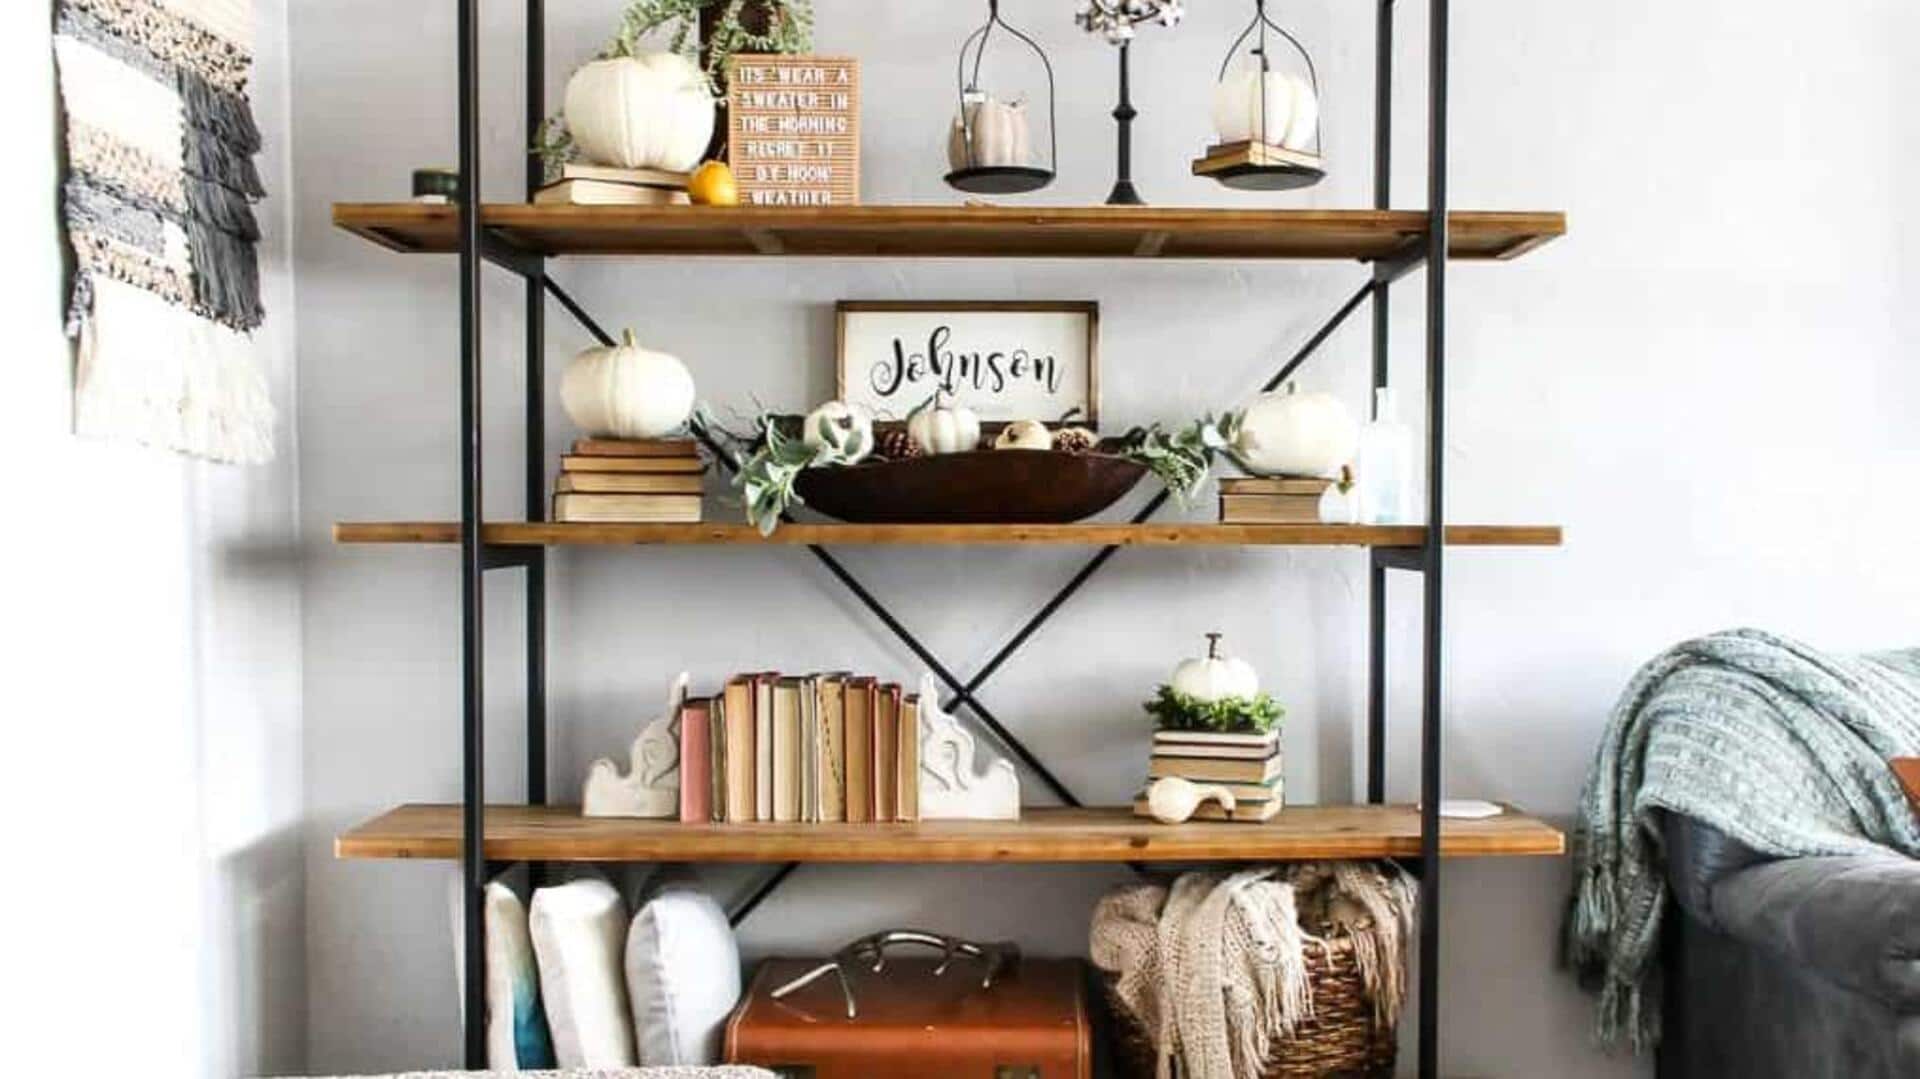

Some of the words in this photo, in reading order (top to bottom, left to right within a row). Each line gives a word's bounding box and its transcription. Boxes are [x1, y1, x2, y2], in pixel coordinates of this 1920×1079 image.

[779, 67, 825, 84] WEAR
[837, 68, 848, 84] A
[742, 91, 818, 109] SWEATER
[832, 92, 848, 109] IN
[741, 116, 768, 133] THE
[779, 117, 847, 134] MORNING
[747, 140, 803, 158] REGRET
[817, 142, 832, 158] IT
[756, 165, 779, 182] BY
[787, 165, 830, 182] NOON
[752, 190, 830, 206] WEATHER
[870, 325, 1064, 396] Johnson
